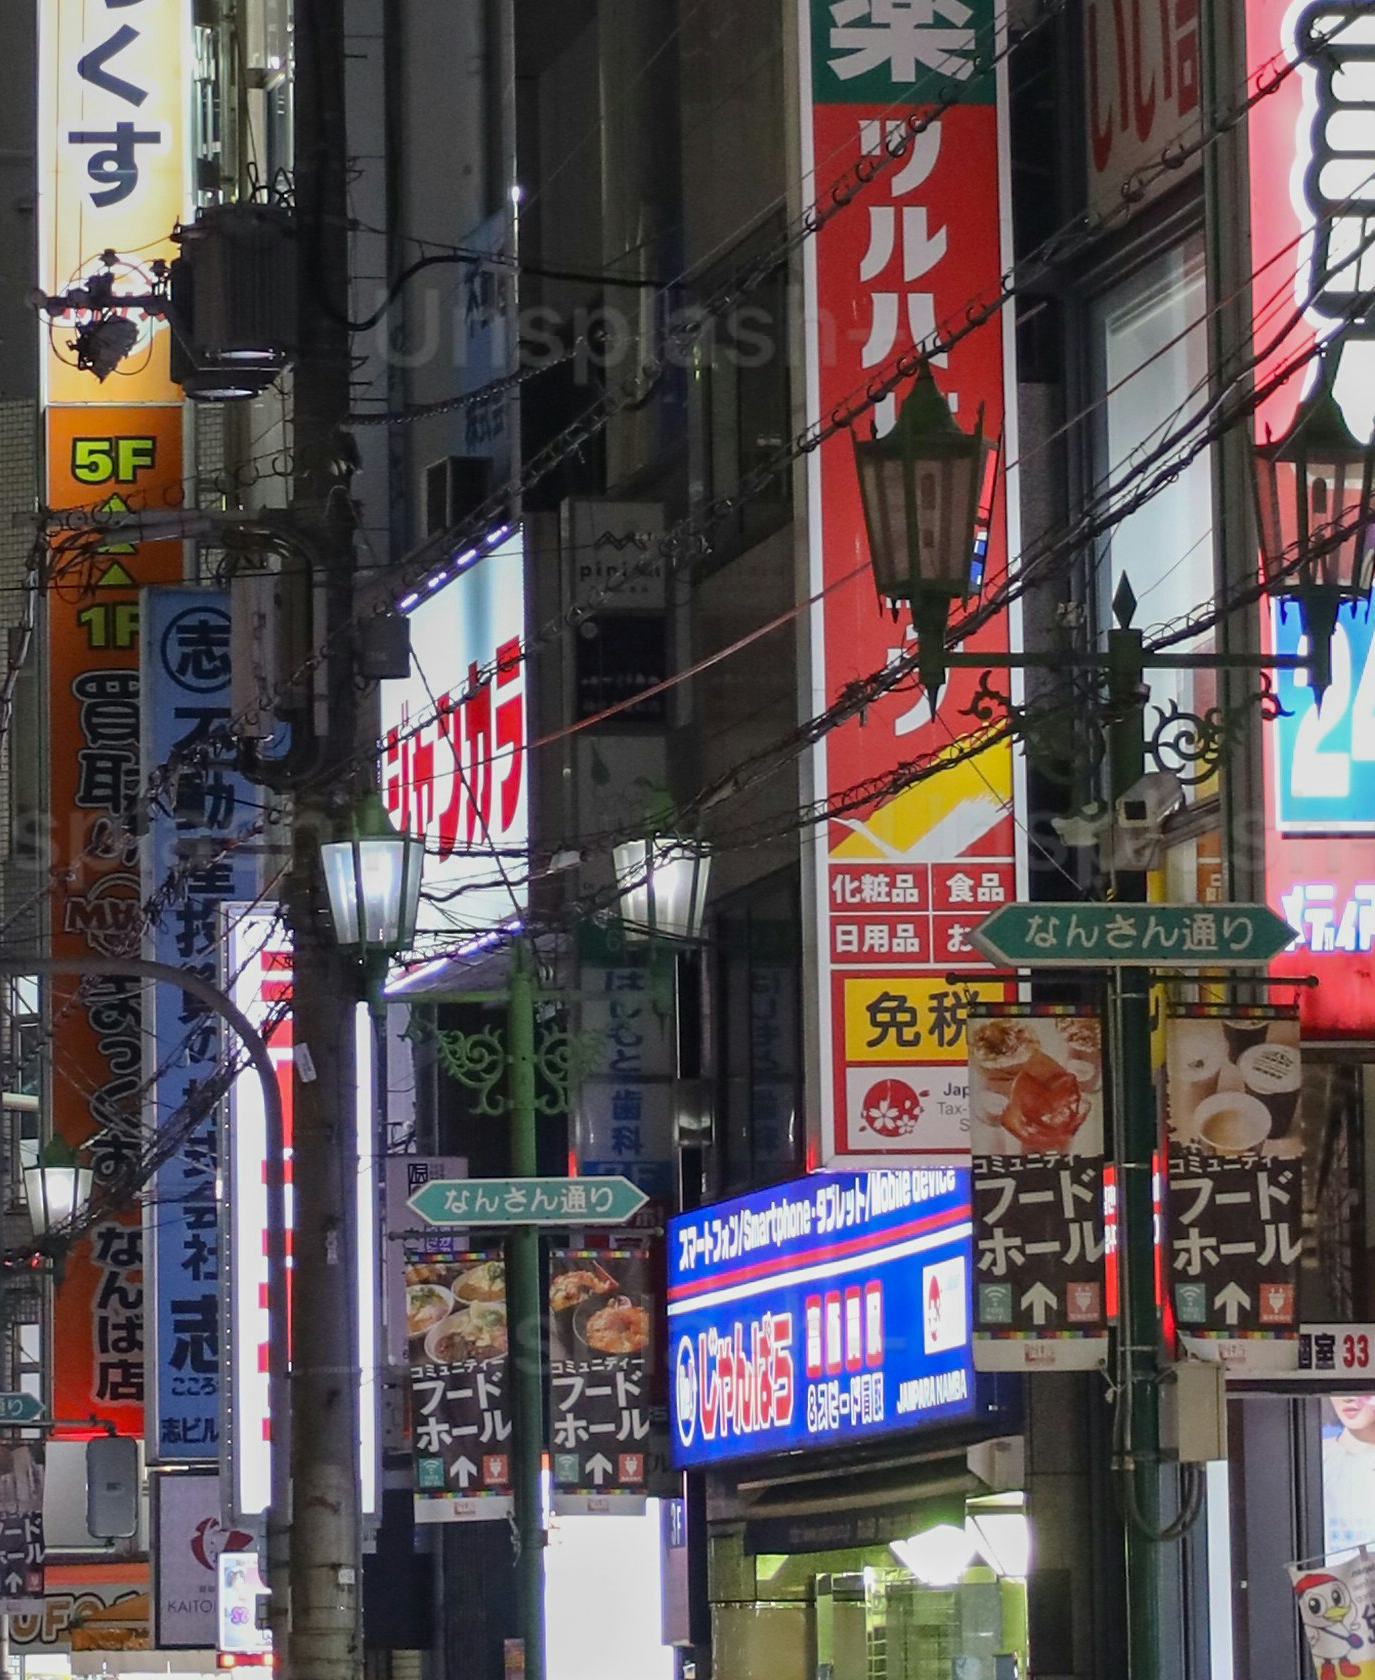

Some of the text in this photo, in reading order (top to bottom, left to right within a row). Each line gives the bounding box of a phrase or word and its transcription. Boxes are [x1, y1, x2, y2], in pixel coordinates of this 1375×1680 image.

[71, 436, 157, 484] 5F
[386, 633, 523, 864] ジャンカラ
[832, 872, 1005, 904] 化粧品 食品
[834, 923, 920, 954] 日用品
[1023, 913, 1254, 953] なんさん通り
[865, 990, 980, 1048] 免税
[942, 1082, 972, 1097] Jap
[443, 1185, 614, 1214] なんさん通り
[974, 1169, 1098, 1226] フード
[1170, 1170, 1293, 1226] フード
[977, 1221, 1106, 1277] ホール
[1173, 1221, 1304, 1277] ホール
[1342, 1333, 1370, 1369] 33
[412, 1370, 502, 1416] フード
[551, 1370, 642, 1415] フード
[698, 1311, 794, 1441] じゃんぱら
[936, 1368, 968, 1406] NAMBA
[416, 1408, 513, 1454] ホール
[552, 1407, 650, 1450] ホール
